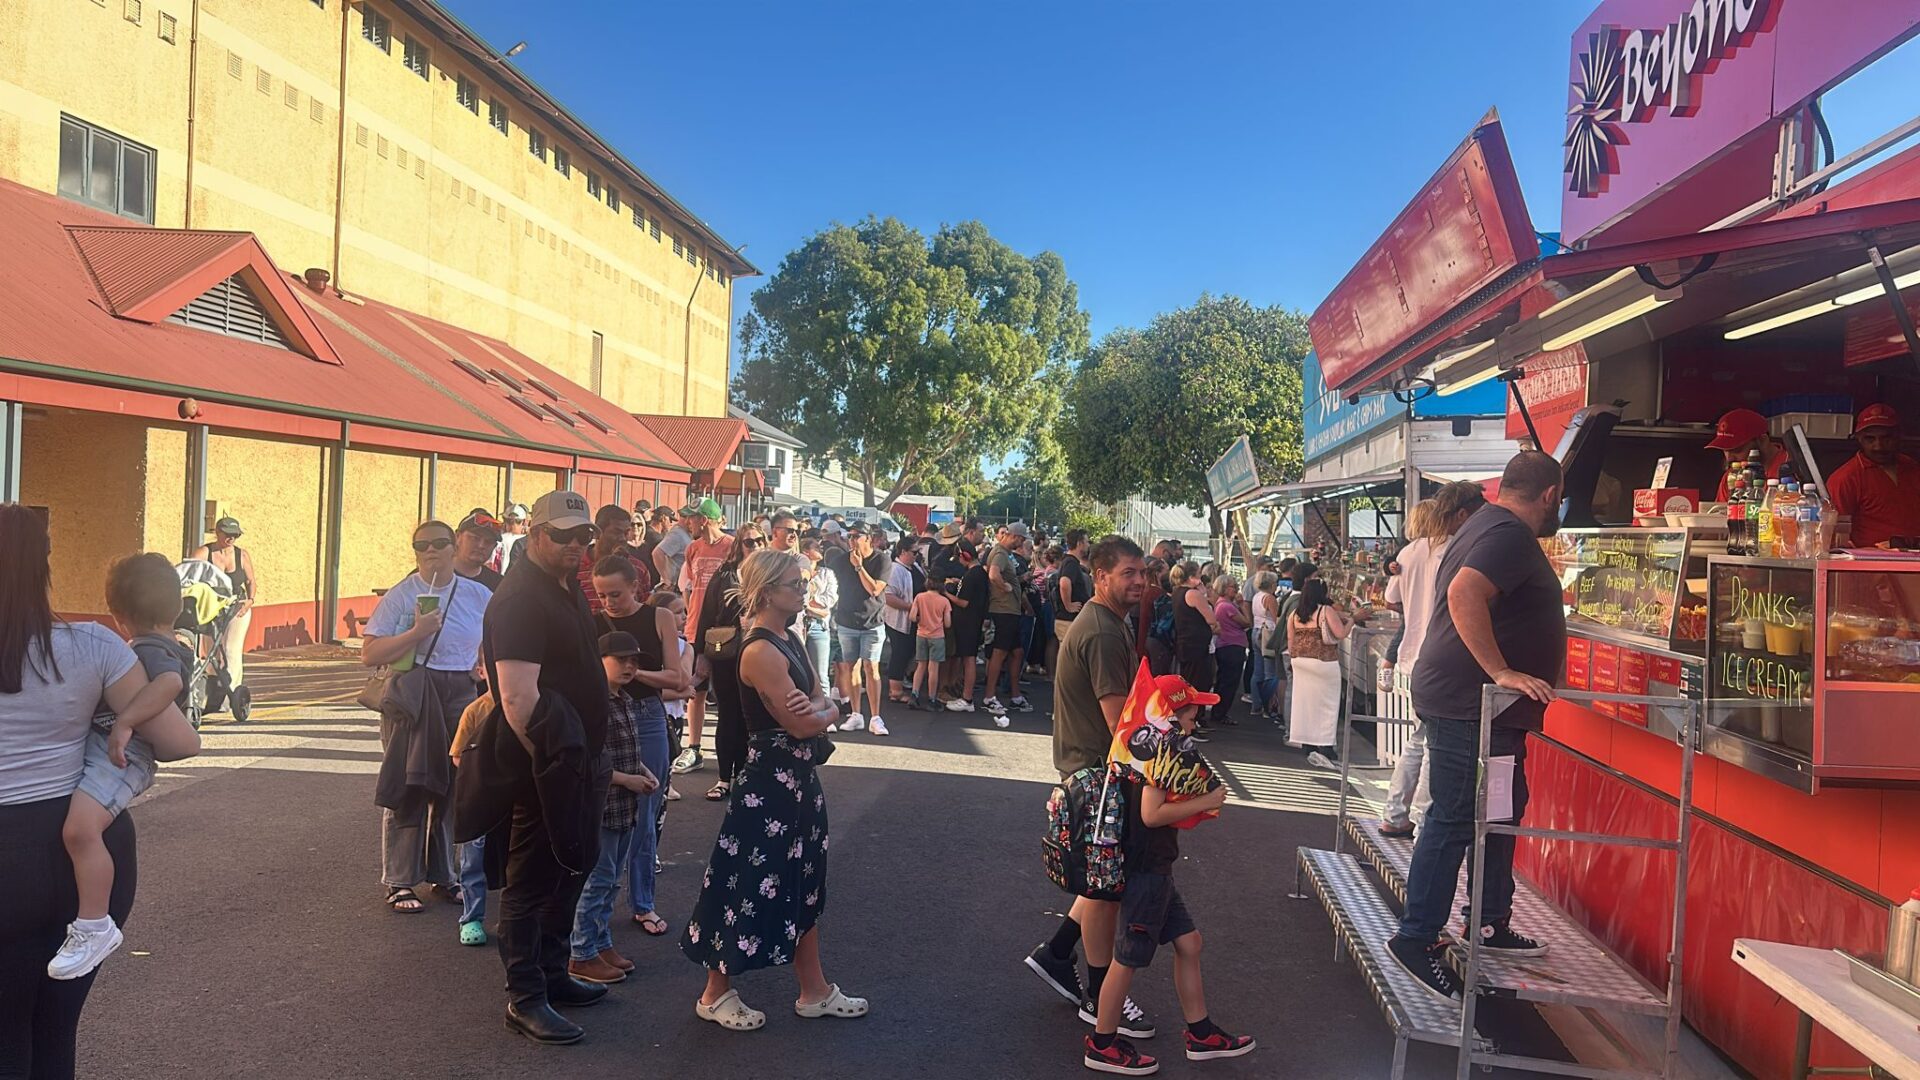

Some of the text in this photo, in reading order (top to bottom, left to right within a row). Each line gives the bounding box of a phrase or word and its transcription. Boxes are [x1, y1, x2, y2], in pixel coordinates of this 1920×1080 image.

[1580, 576, 1596, 594] BEEF
[1731, 576, 1796, 628] DRINKS
[1153, 740, 1211, 794] Wicked
